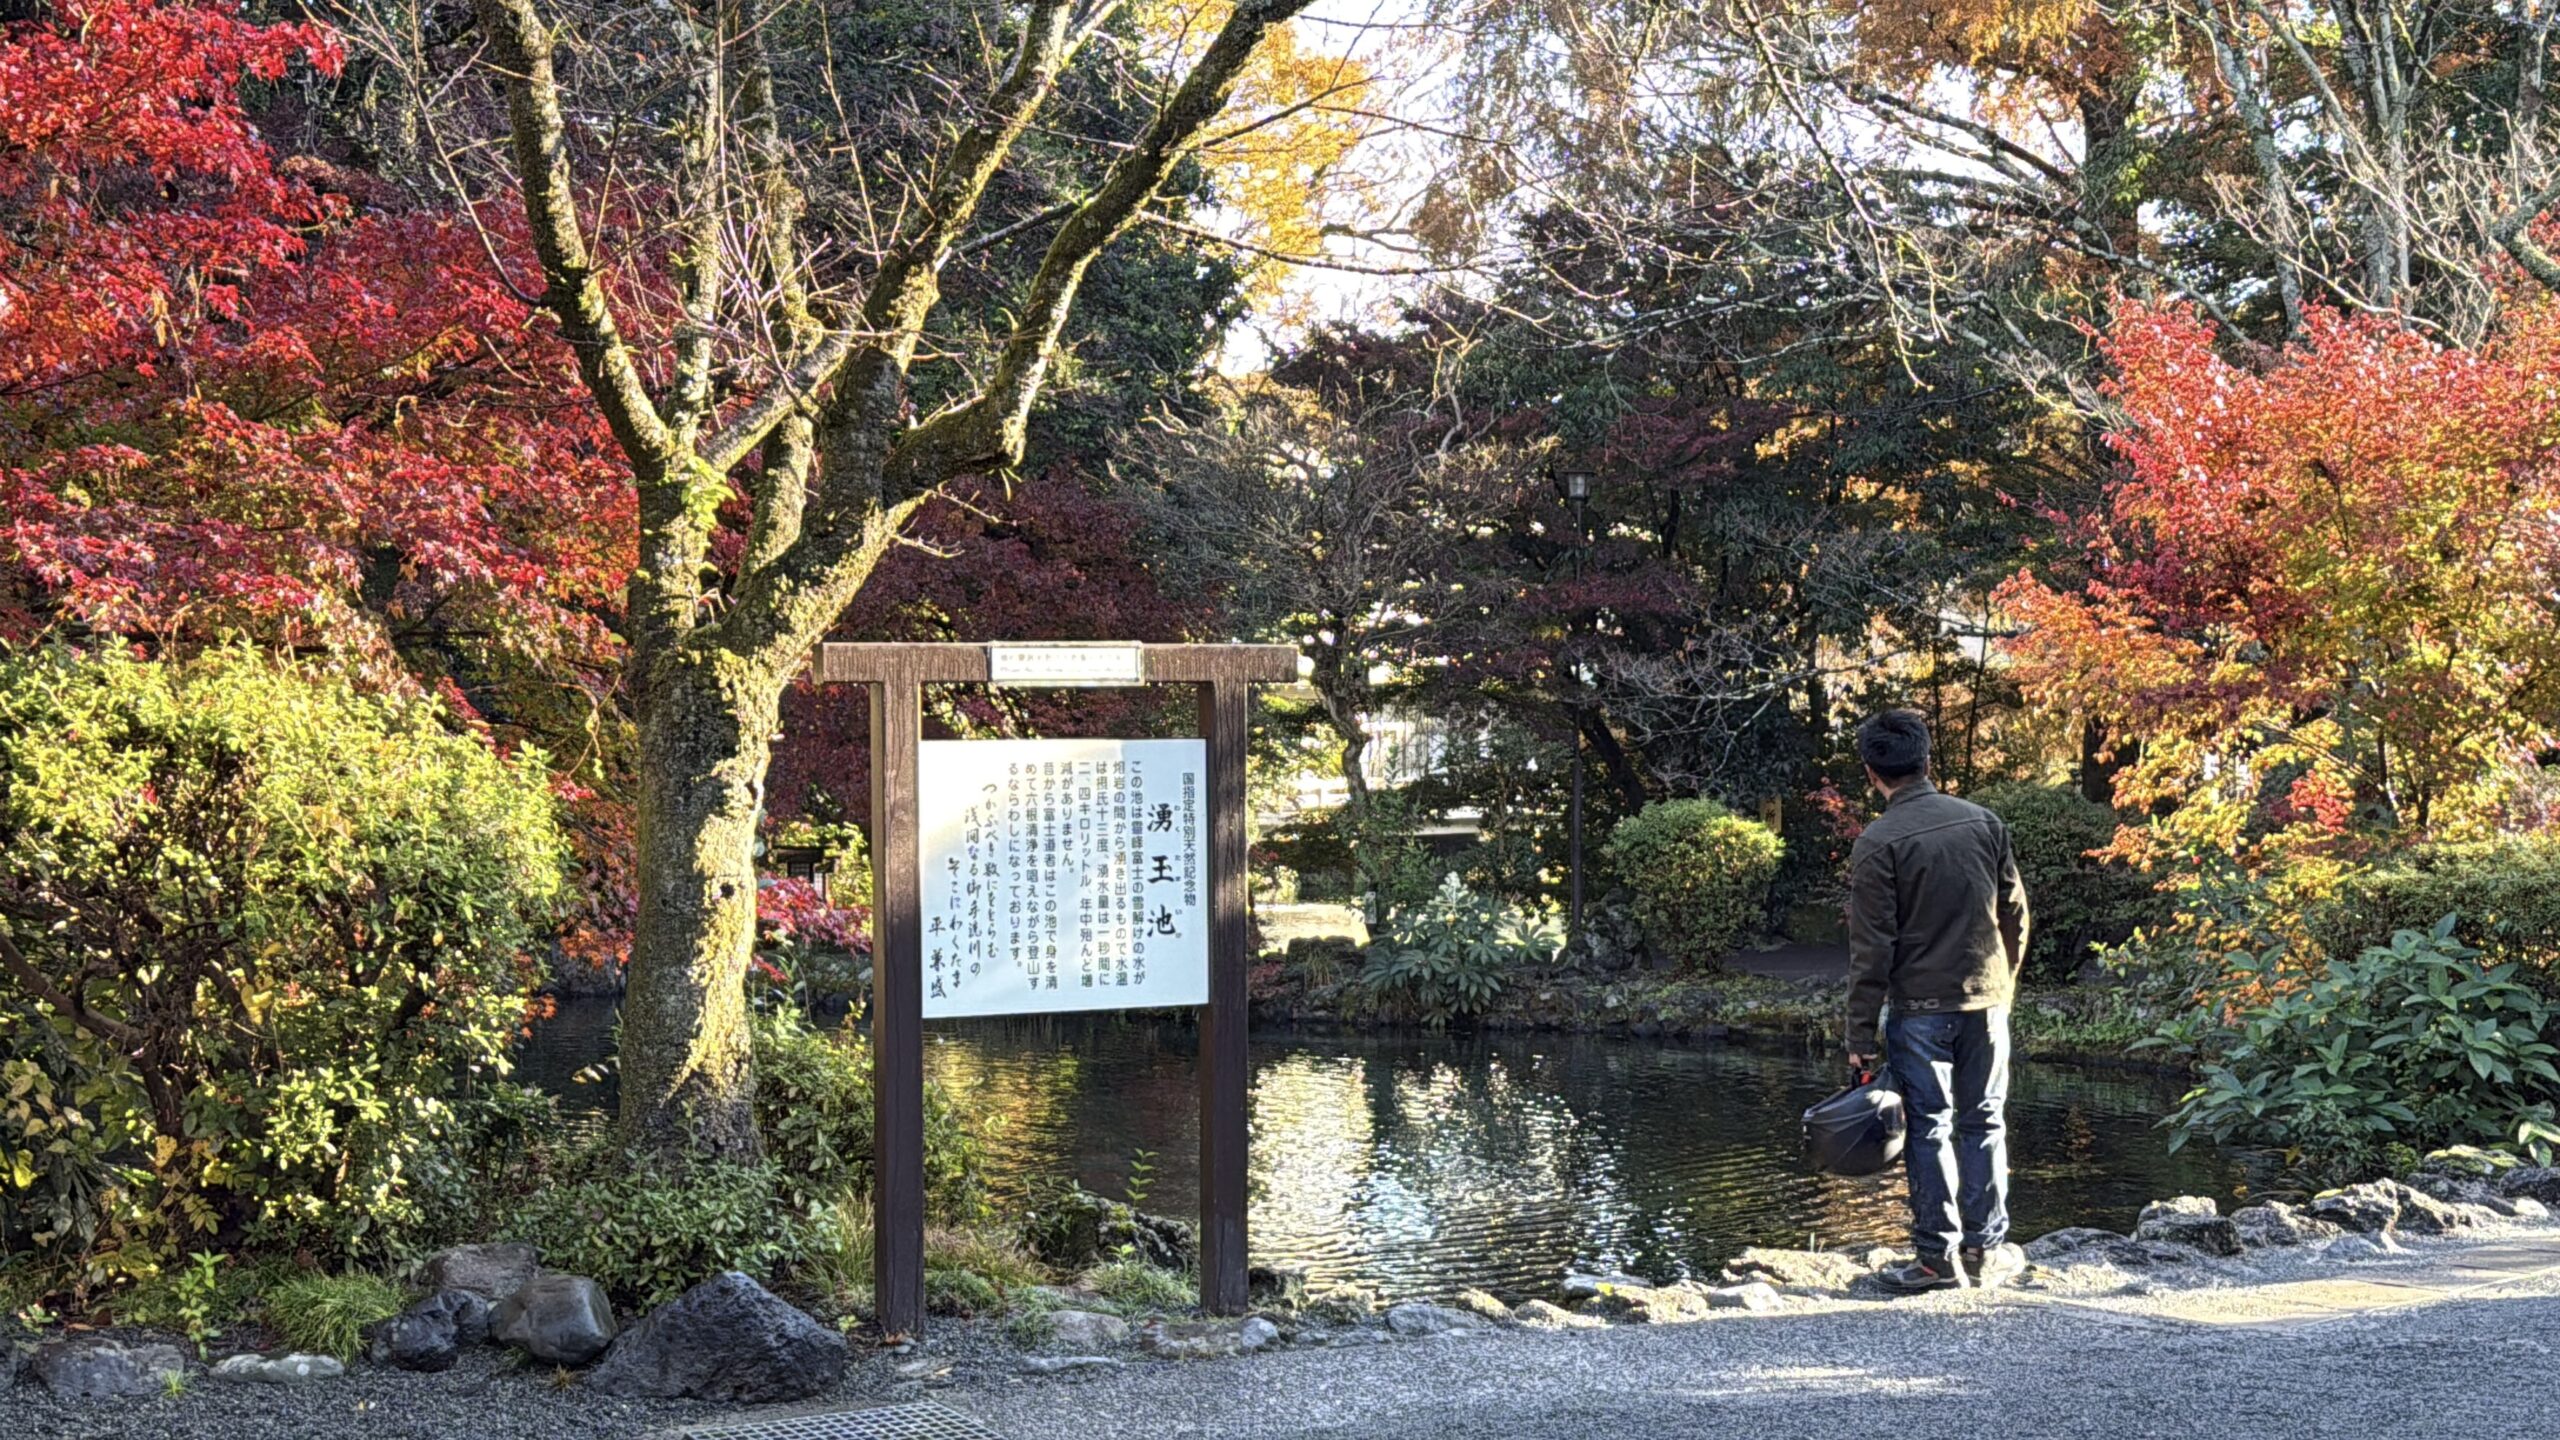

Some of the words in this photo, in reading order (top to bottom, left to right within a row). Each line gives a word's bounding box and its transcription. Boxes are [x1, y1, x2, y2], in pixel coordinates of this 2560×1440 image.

[1008, 762, 1022, 967] るならわしになっております。
[1025, 763, 1040, 990] めて六根清浄を唱えながら登山す
[1043, 761, 1058, 990] 昔から富士道者はこの池で身を清
[1060, 761, 1075, 874] 減がありません。
[1146, 802, 1177, 938] 湧玉池
[1182, 772, 1197, 907] 国指定特別天然記念物
